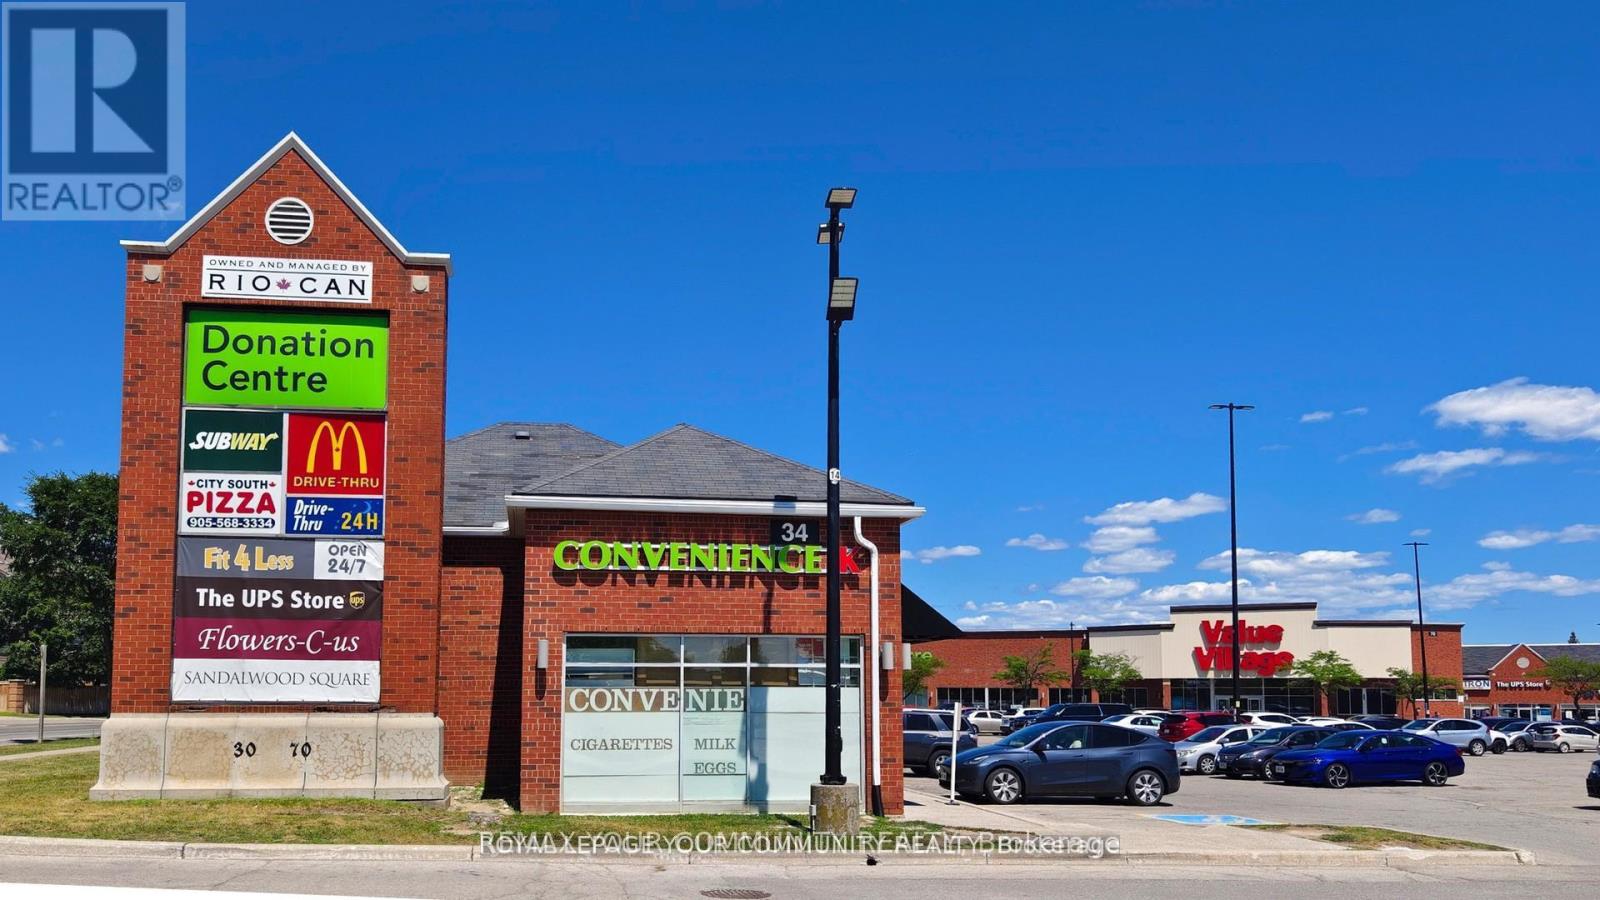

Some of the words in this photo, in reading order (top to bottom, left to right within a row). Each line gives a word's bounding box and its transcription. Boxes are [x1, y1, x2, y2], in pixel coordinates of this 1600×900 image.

[209, 259, 254, 268] OWNED
[259, 261, 284, 269] AND
[289, 262, 347, 271] MANAGED
[352, 264, 366, 272] BY
[209, 273, 271, 291] RIO
[299, 277, 366, 296] CAN
[203, 324, 374, 359] Donation
[202, 360, 328, 393] Centre
[188, 431, 279, 451] SUBWAY
[196, 479, 225, 489] CITY
[227, 480, 269, 490] SOUTH
[294, 476, 379, 488] DRIVE-THRU
[187, 491, 276, 514] PIZZA
[294, 500, 334, 516] Drive-
[189, 517, 273, 528] 905-568-3334
[293, 515, 323, 531] Thru
[781, 523, 808, 542] 34
[204, 547, 230, 571] Fit
[234, 543, 250, 571] 4
[254, 546, 294, 571] Less
[328, 544, 367, 557] OPEN
[553, 540, 822, 574] CONVENIENCE
[327, 559, 366, 575] 24/7
[196, 588, 234, 607] The
[242, 589, 284, 608] UPS
[290, 590, 345, 609] Store
[351, 596, 365, 607] ups
[198, 625, 360, 654] Flowers-C-us
[1201, 620, 1284, 644] Value
[1194, 646, 1294, 677] Vilage
[184, 670, 305, 686] SANDALWOOD
[309, 672, 370, 689] SQUARE
[569, 688, 744, 712] CONVENIE
[234, 742, 256, 758] 30
[290, 742, 311, 758] 70
[570, 738, 673, 751] CIGARETTES
[694, 738, 737, 750] MILK
[694, 762, 737, 774] EGGS
